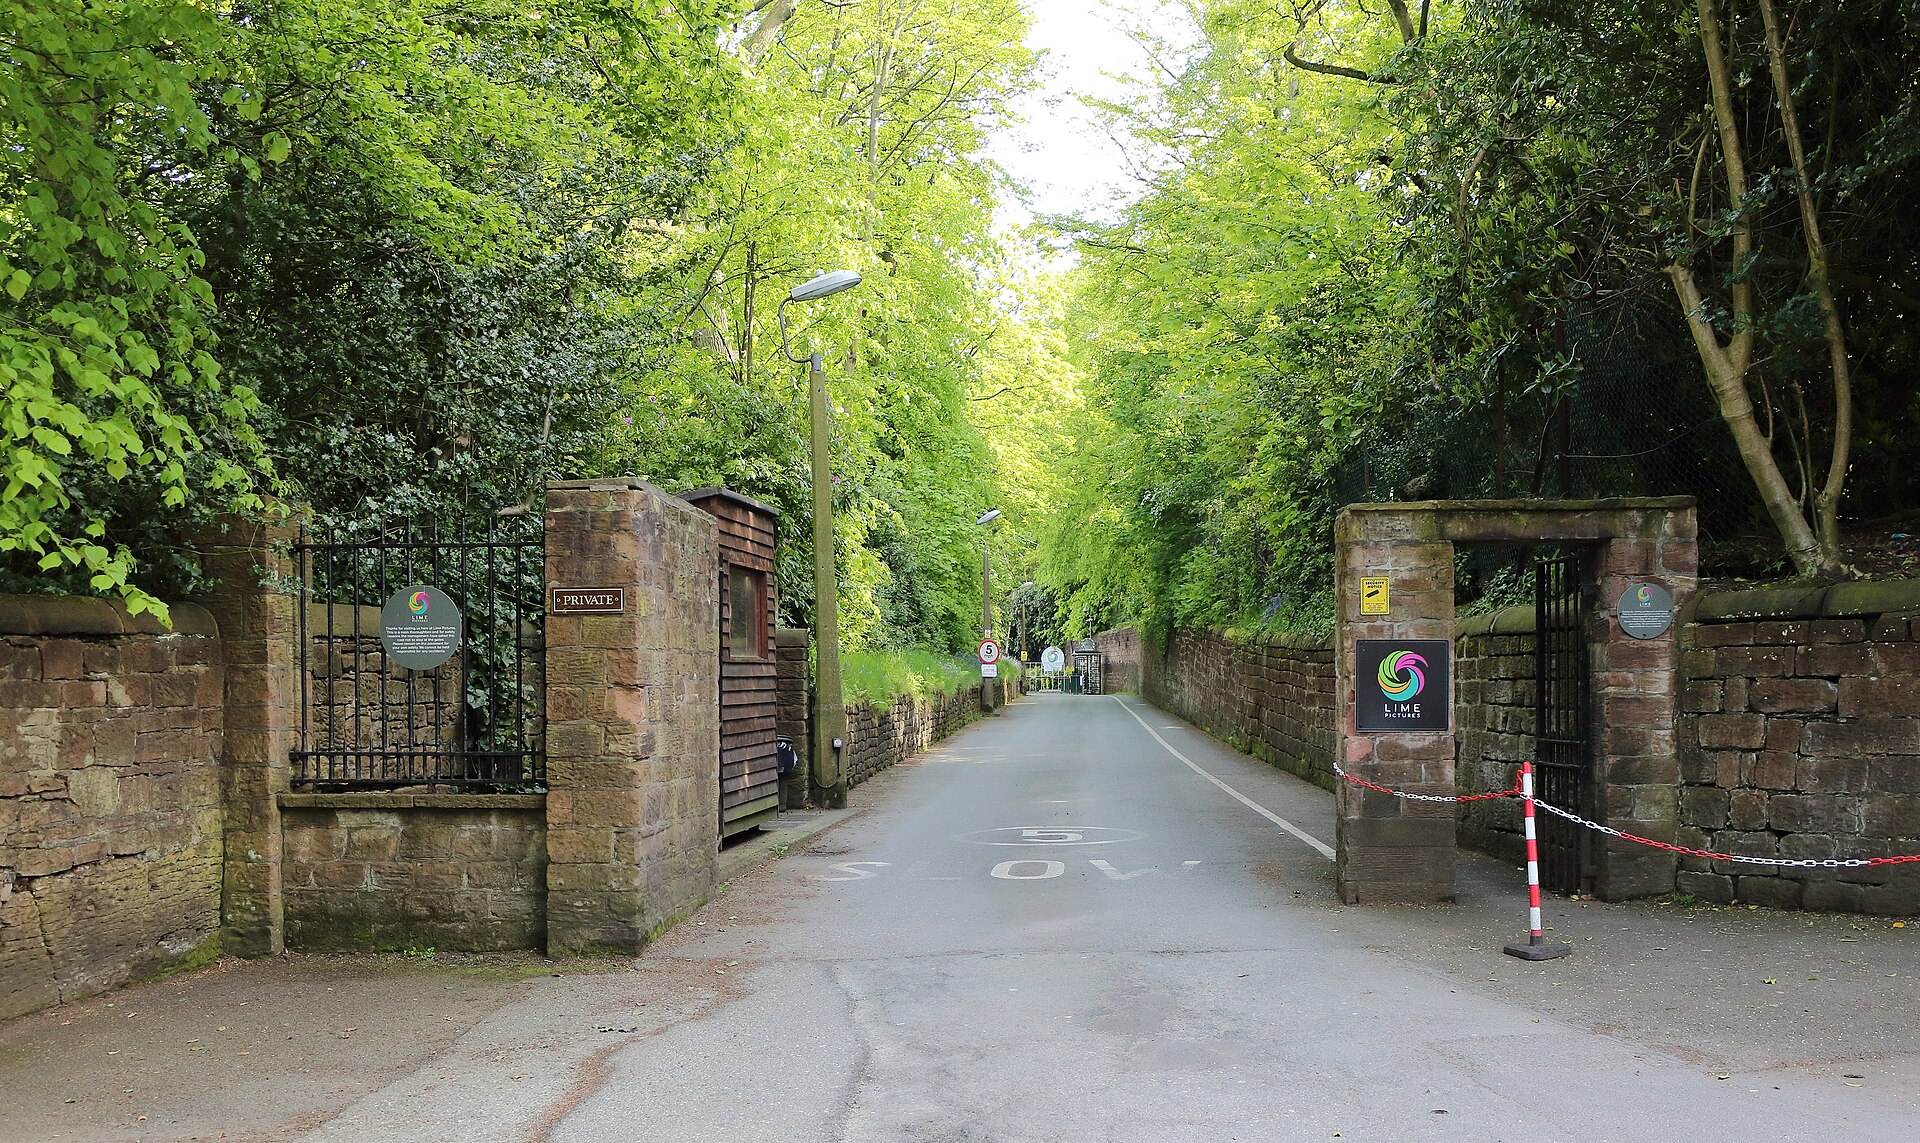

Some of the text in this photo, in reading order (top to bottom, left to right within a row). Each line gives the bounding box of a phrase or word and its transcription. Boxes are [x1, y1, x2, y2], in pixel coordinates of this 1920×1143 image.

[563, 594, 614, 606] PRIVATE
[986, 645, 992, 654] 5
[1385, 703, 1420, 712] LIME
[1021, 829, 1085, 842] 5
